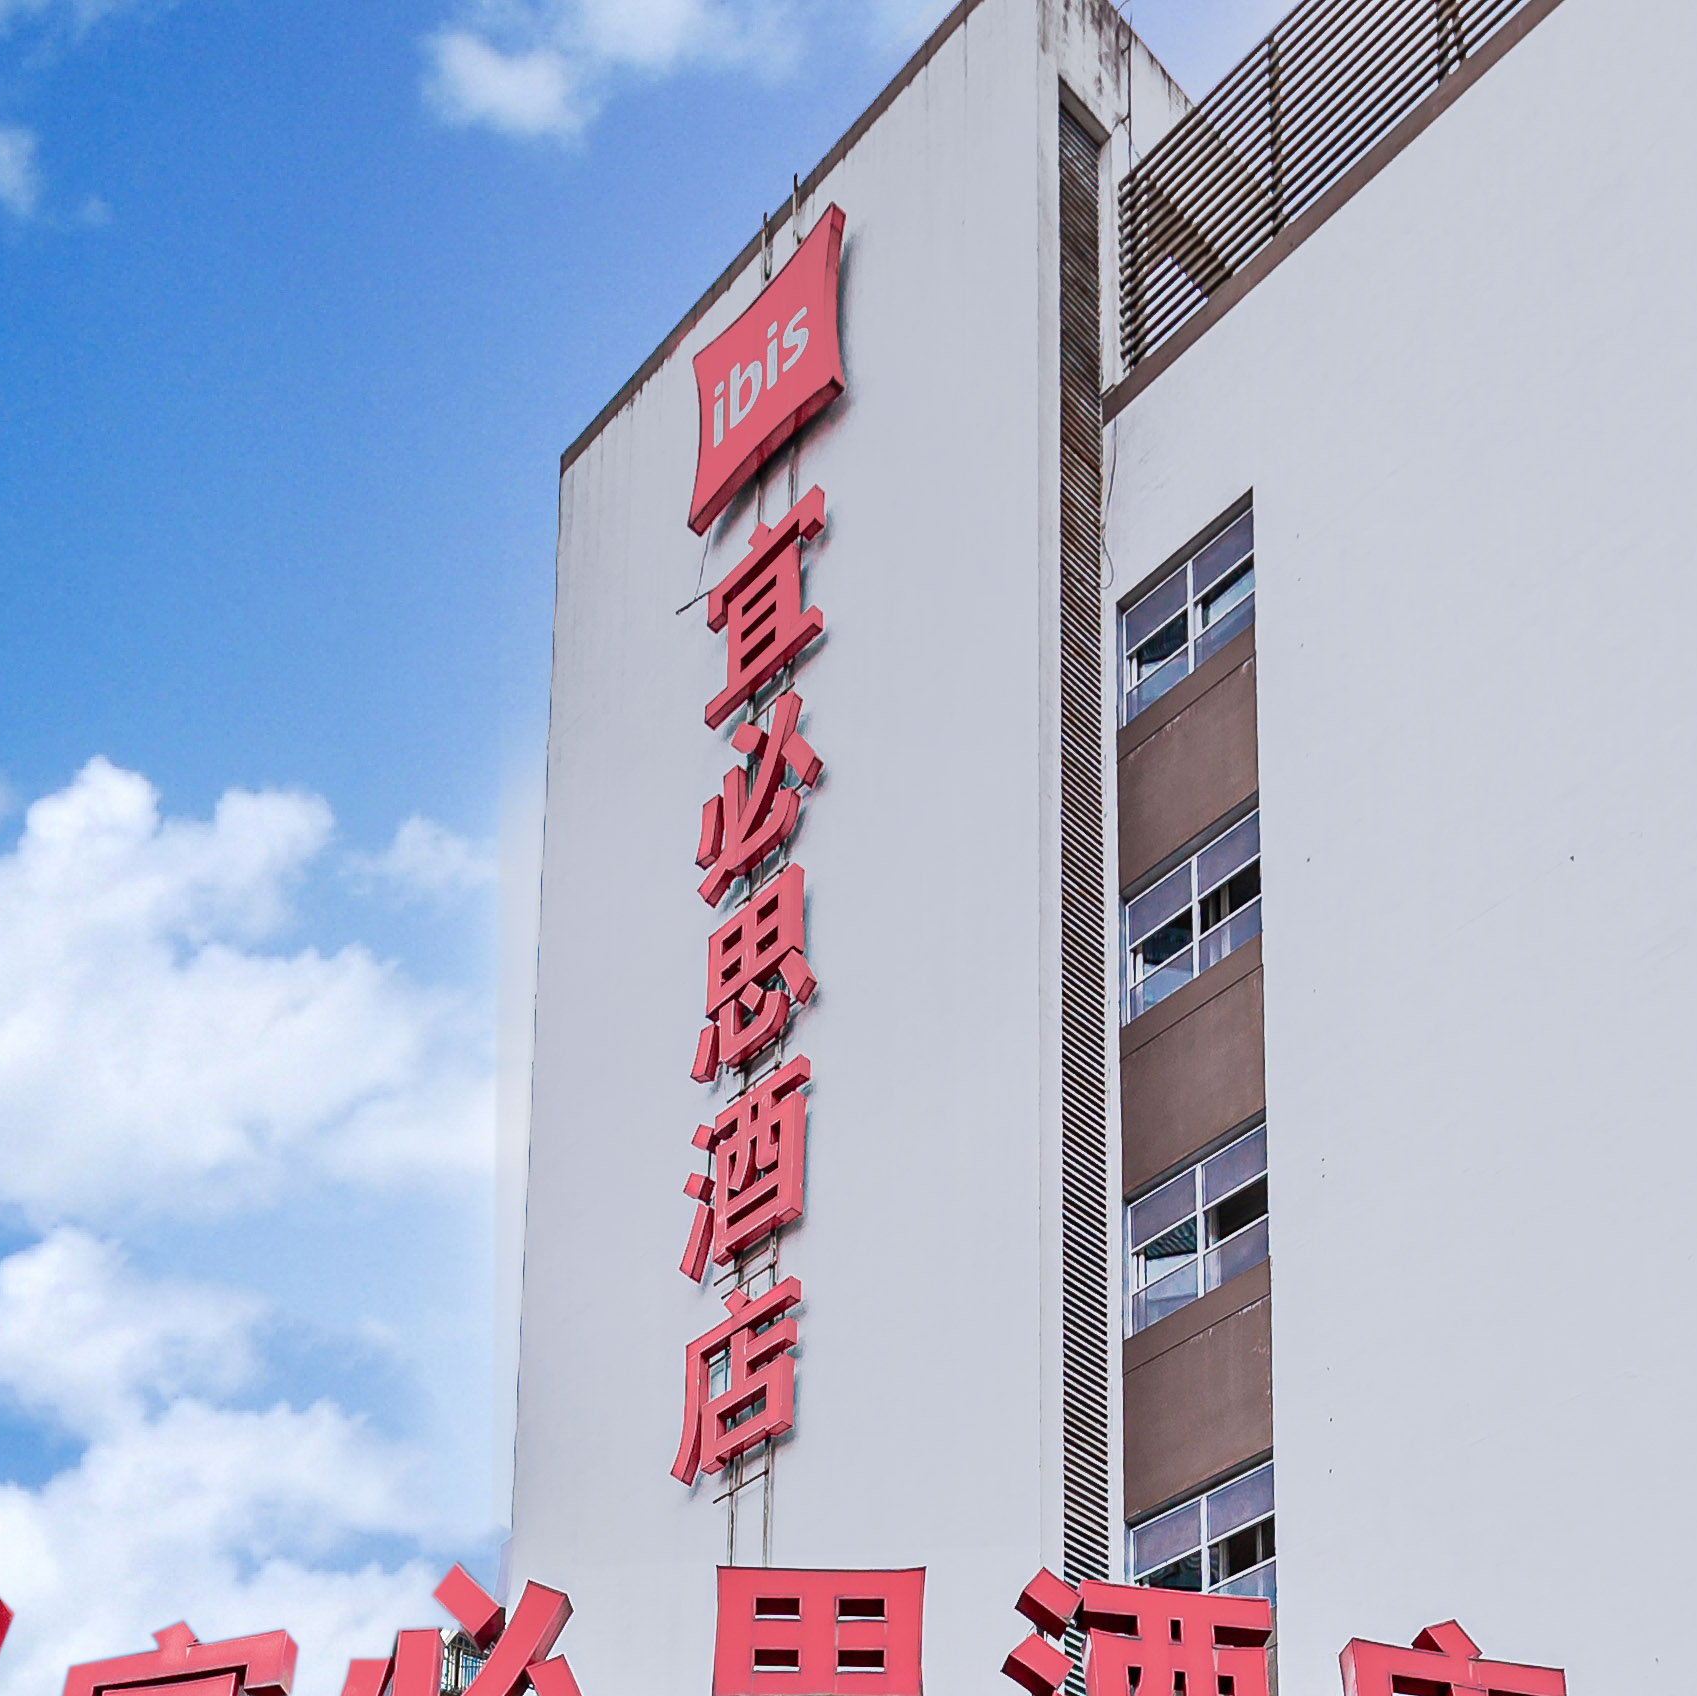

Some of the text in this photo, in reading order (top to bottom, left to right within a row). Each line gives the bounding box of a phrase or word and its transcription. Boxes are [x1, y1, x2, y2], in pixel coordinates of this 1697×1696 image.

[712, 305, 810, 447] ibis
[670, 484, 826, 1486] 宜必思酒店
